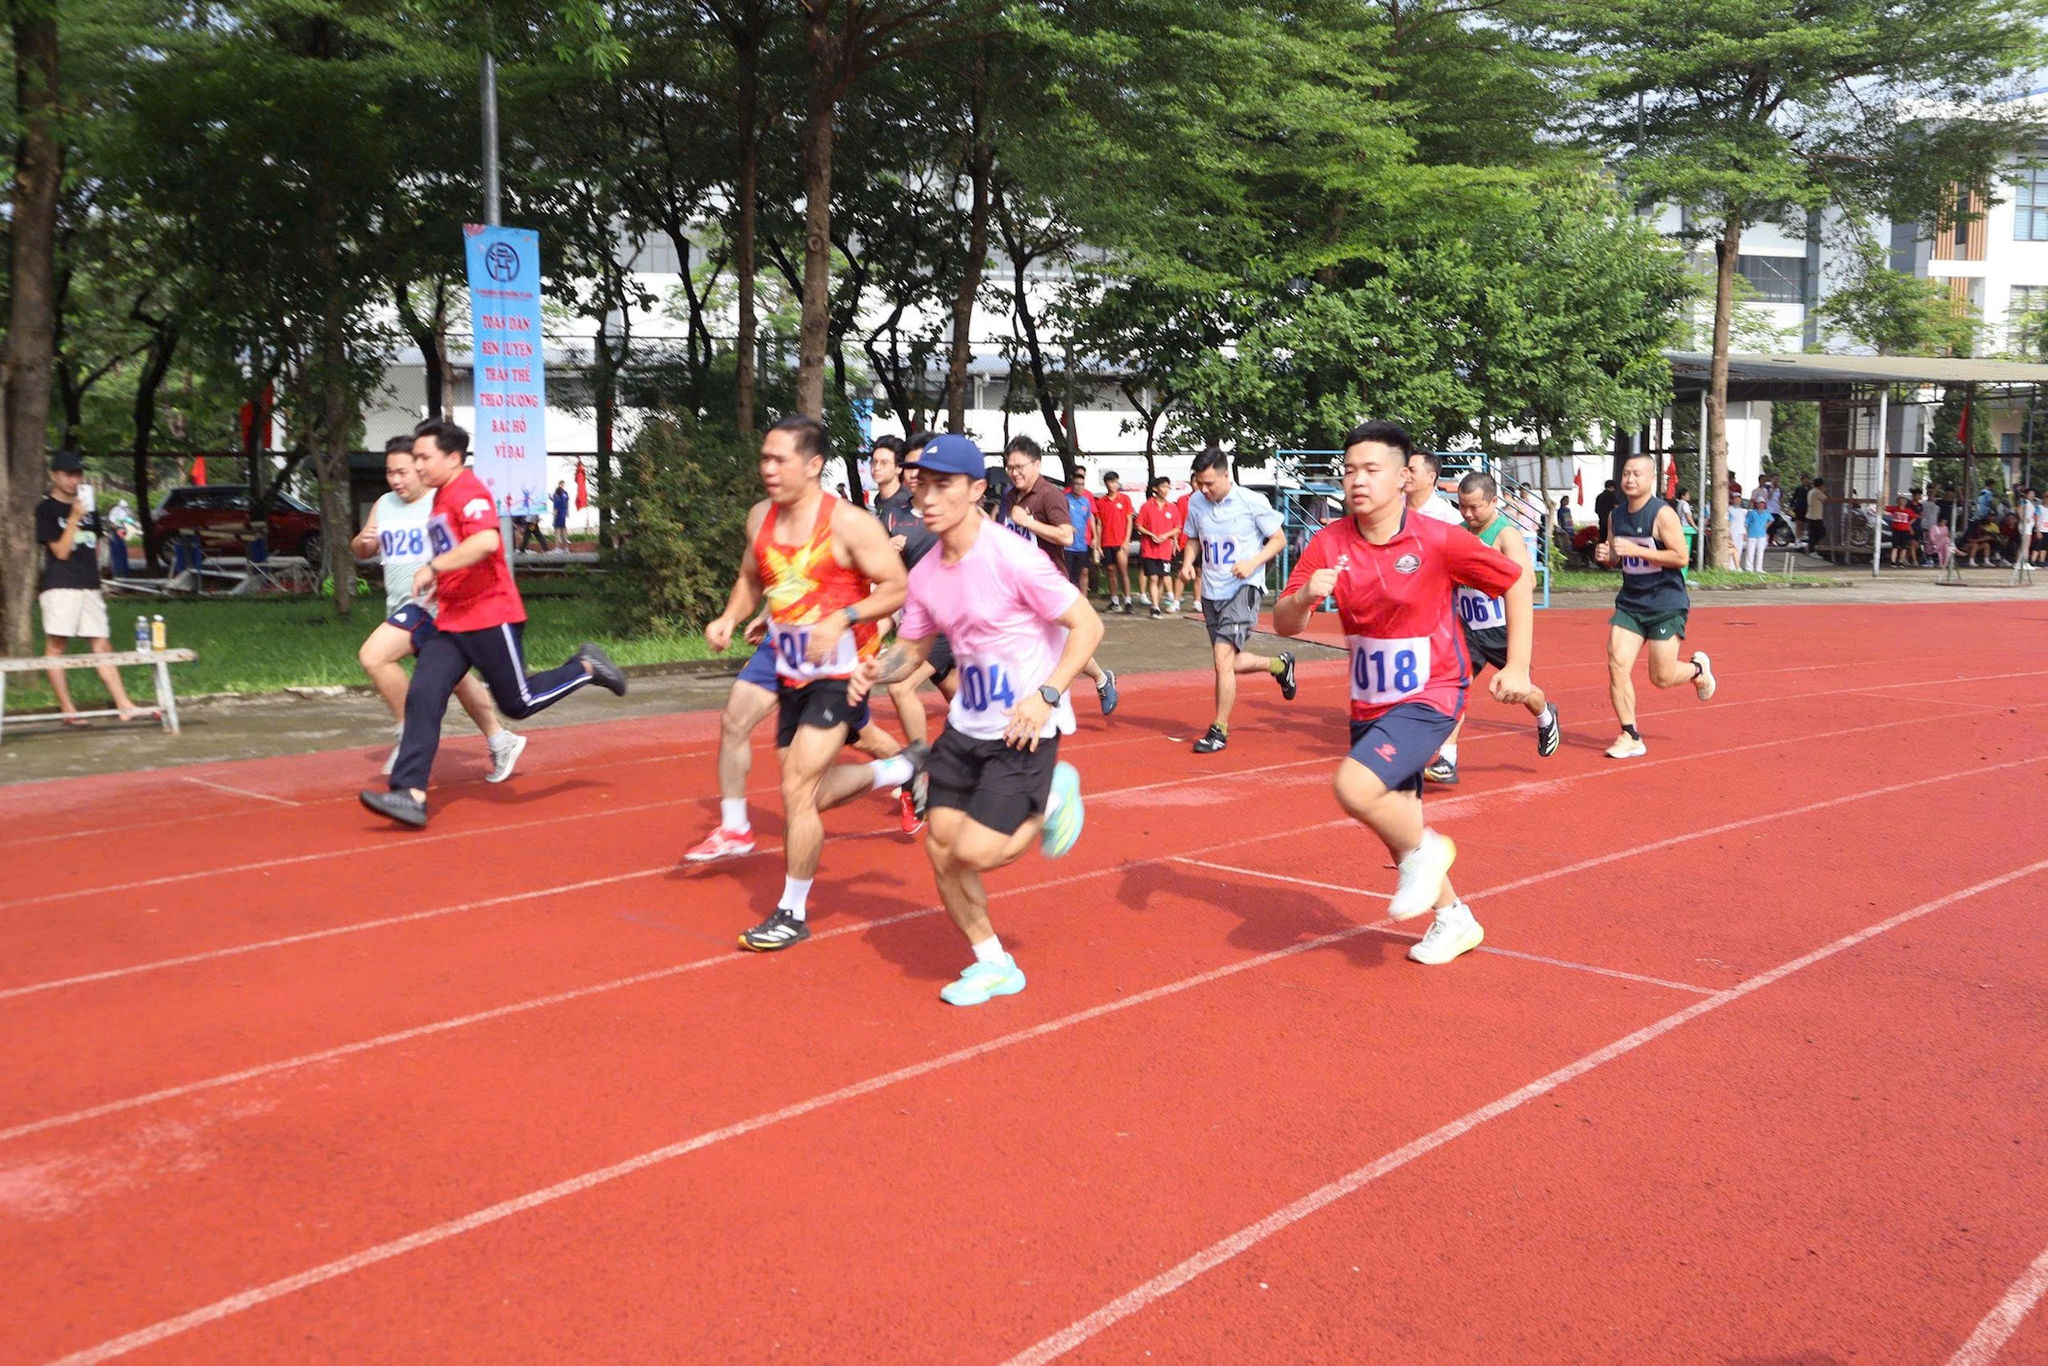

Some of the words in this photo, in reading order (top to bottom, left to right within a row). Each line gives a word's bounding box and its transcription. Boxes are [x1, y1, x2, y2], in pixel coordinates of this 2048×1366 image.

[382, 528, 424, 557] 028
[1203, 538, 1235, 565] 012
[1460, 595, 1503, 623] 061
[1354, 645, 1418, 692] 018
